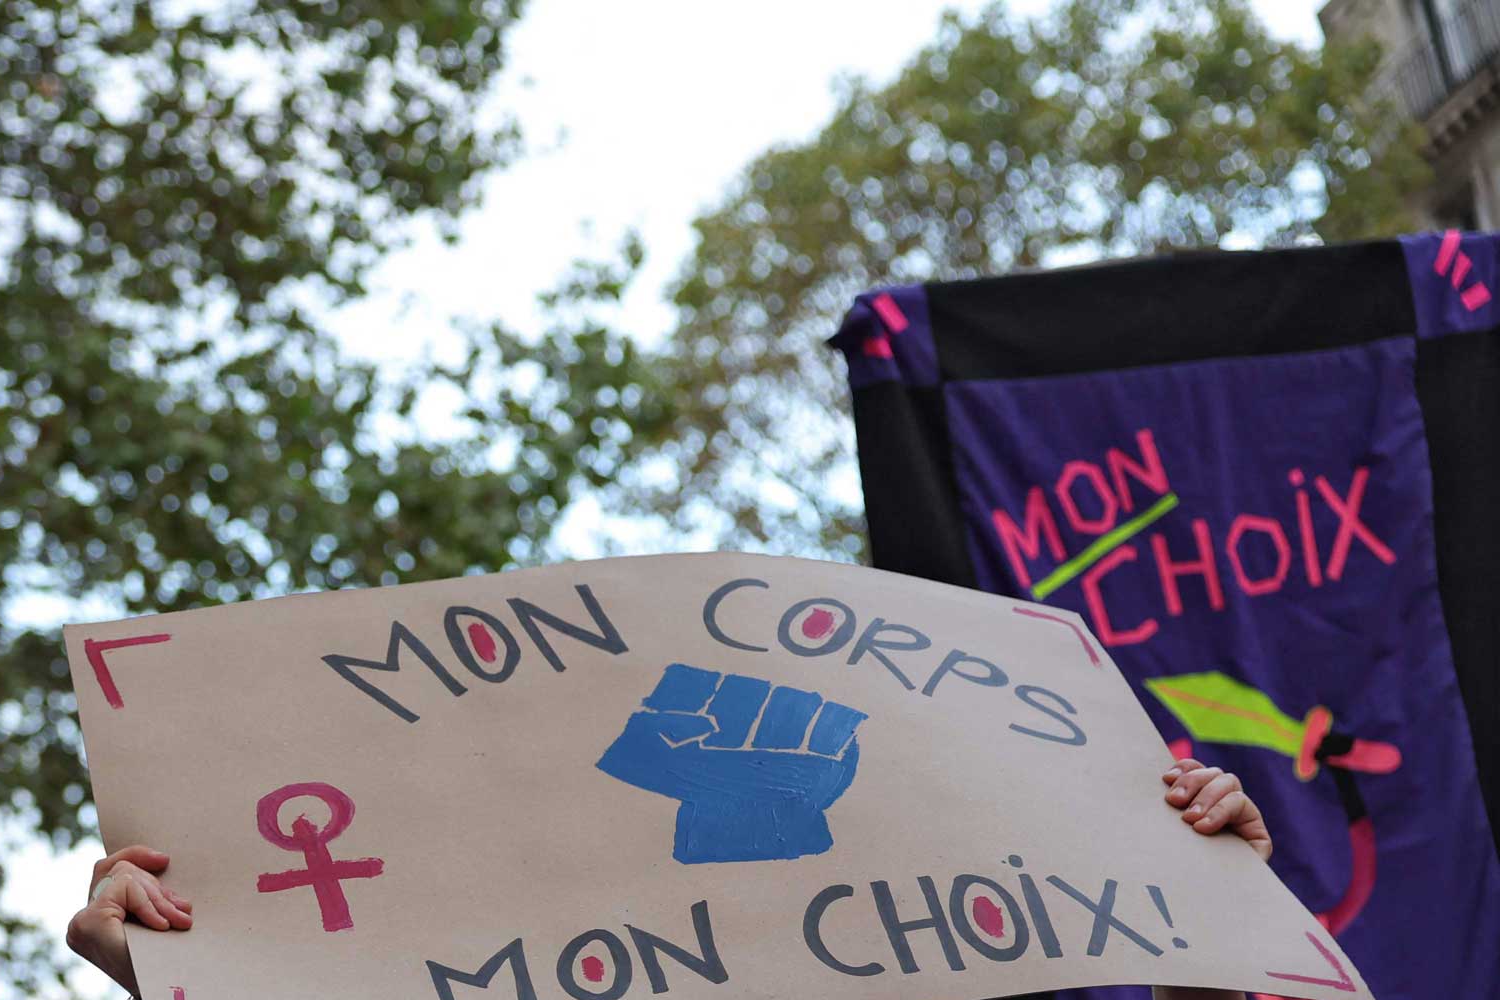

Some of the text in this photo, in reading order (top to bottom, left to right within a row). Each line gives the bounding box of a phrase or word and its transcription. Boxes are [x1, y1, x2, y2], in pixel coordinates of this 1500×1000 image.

[991, 428, 1171, 590] MON
[320, 577, 1089, 746] MON CORPS
